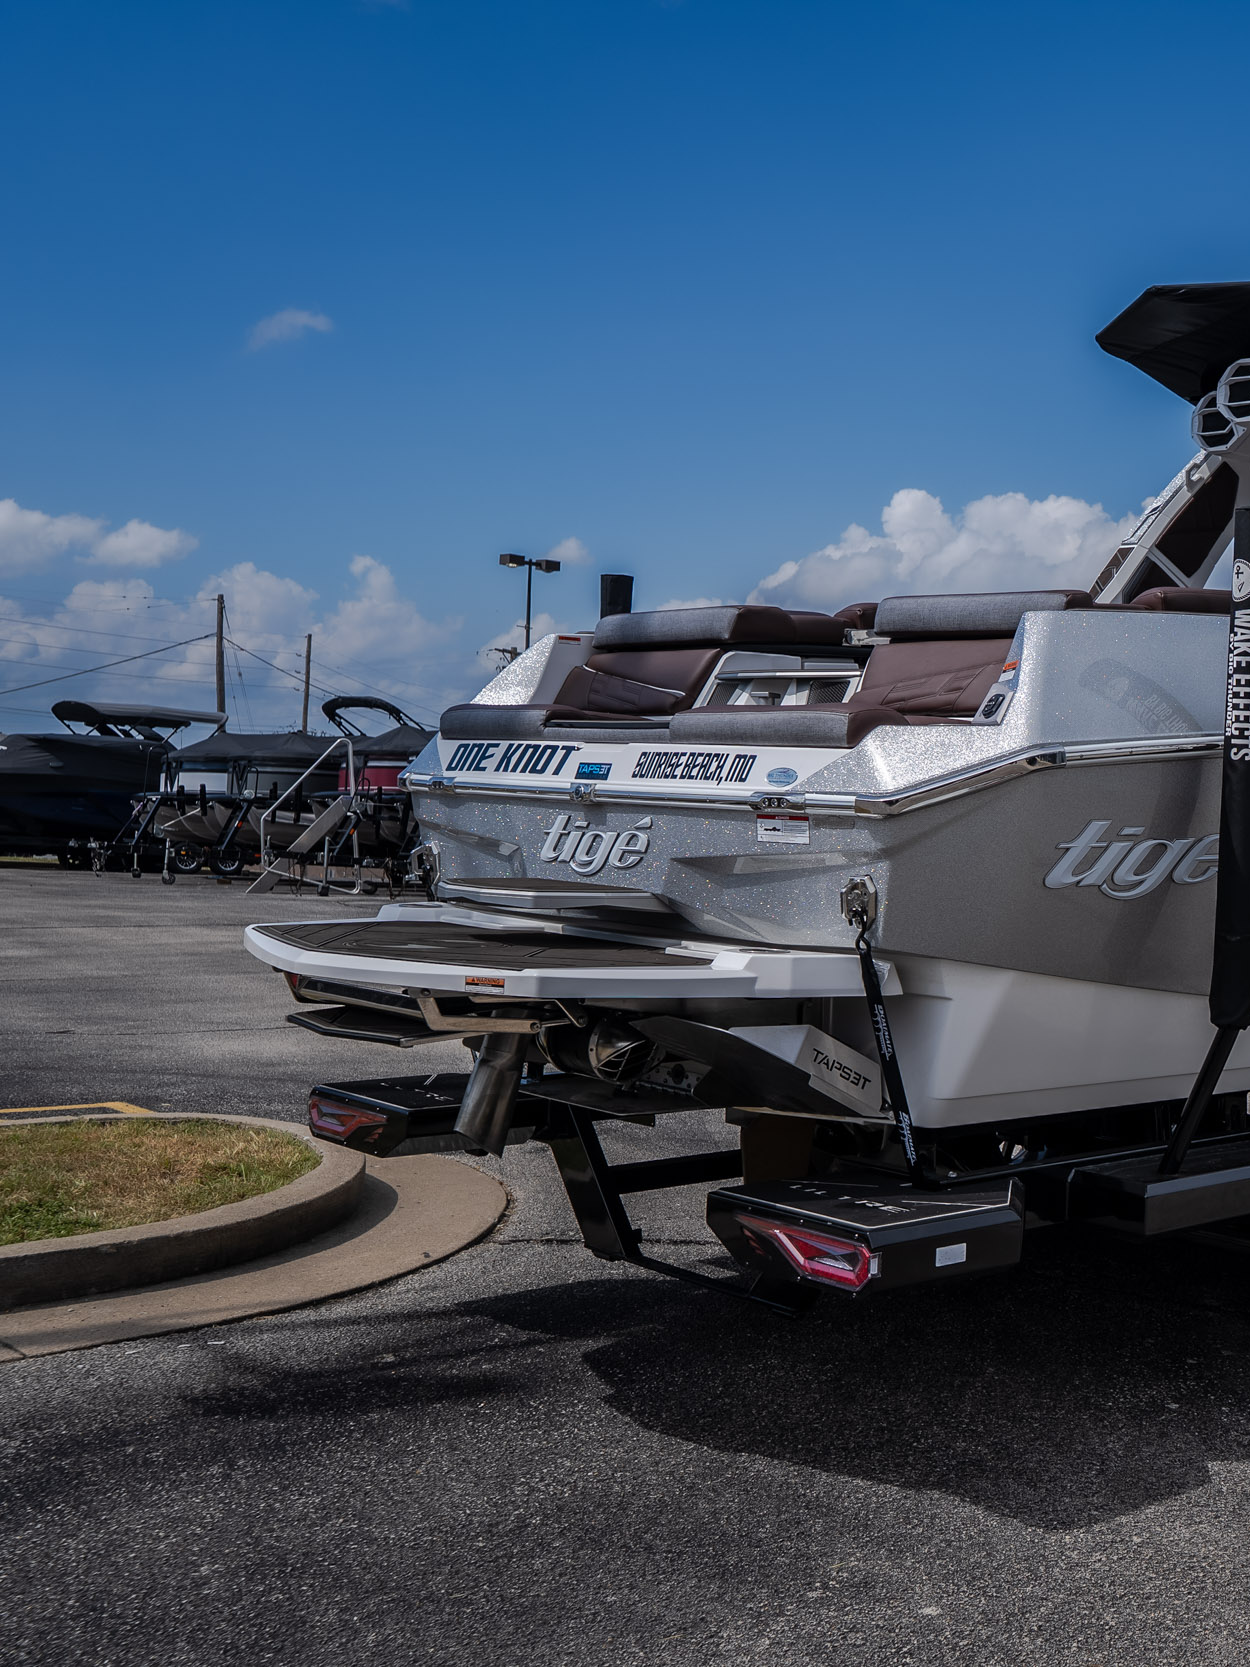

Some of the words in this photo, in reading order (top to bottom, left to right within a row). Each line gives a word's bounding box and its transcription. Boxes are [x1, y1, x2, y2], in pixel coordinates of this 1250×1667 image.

[1229, 633, 1234, 650] BY
[1225, 678, 1233, 736] THUNDER
[445, 742, 501, 772] ONE
[493, 743, 580, 776] KNOT
[631, 751, 688, 780] SUNRISE
[678, 752, 730, 787] BEACH,
[724, 754, 758, 783] MO
[540, 815, 653, 876] tigé
